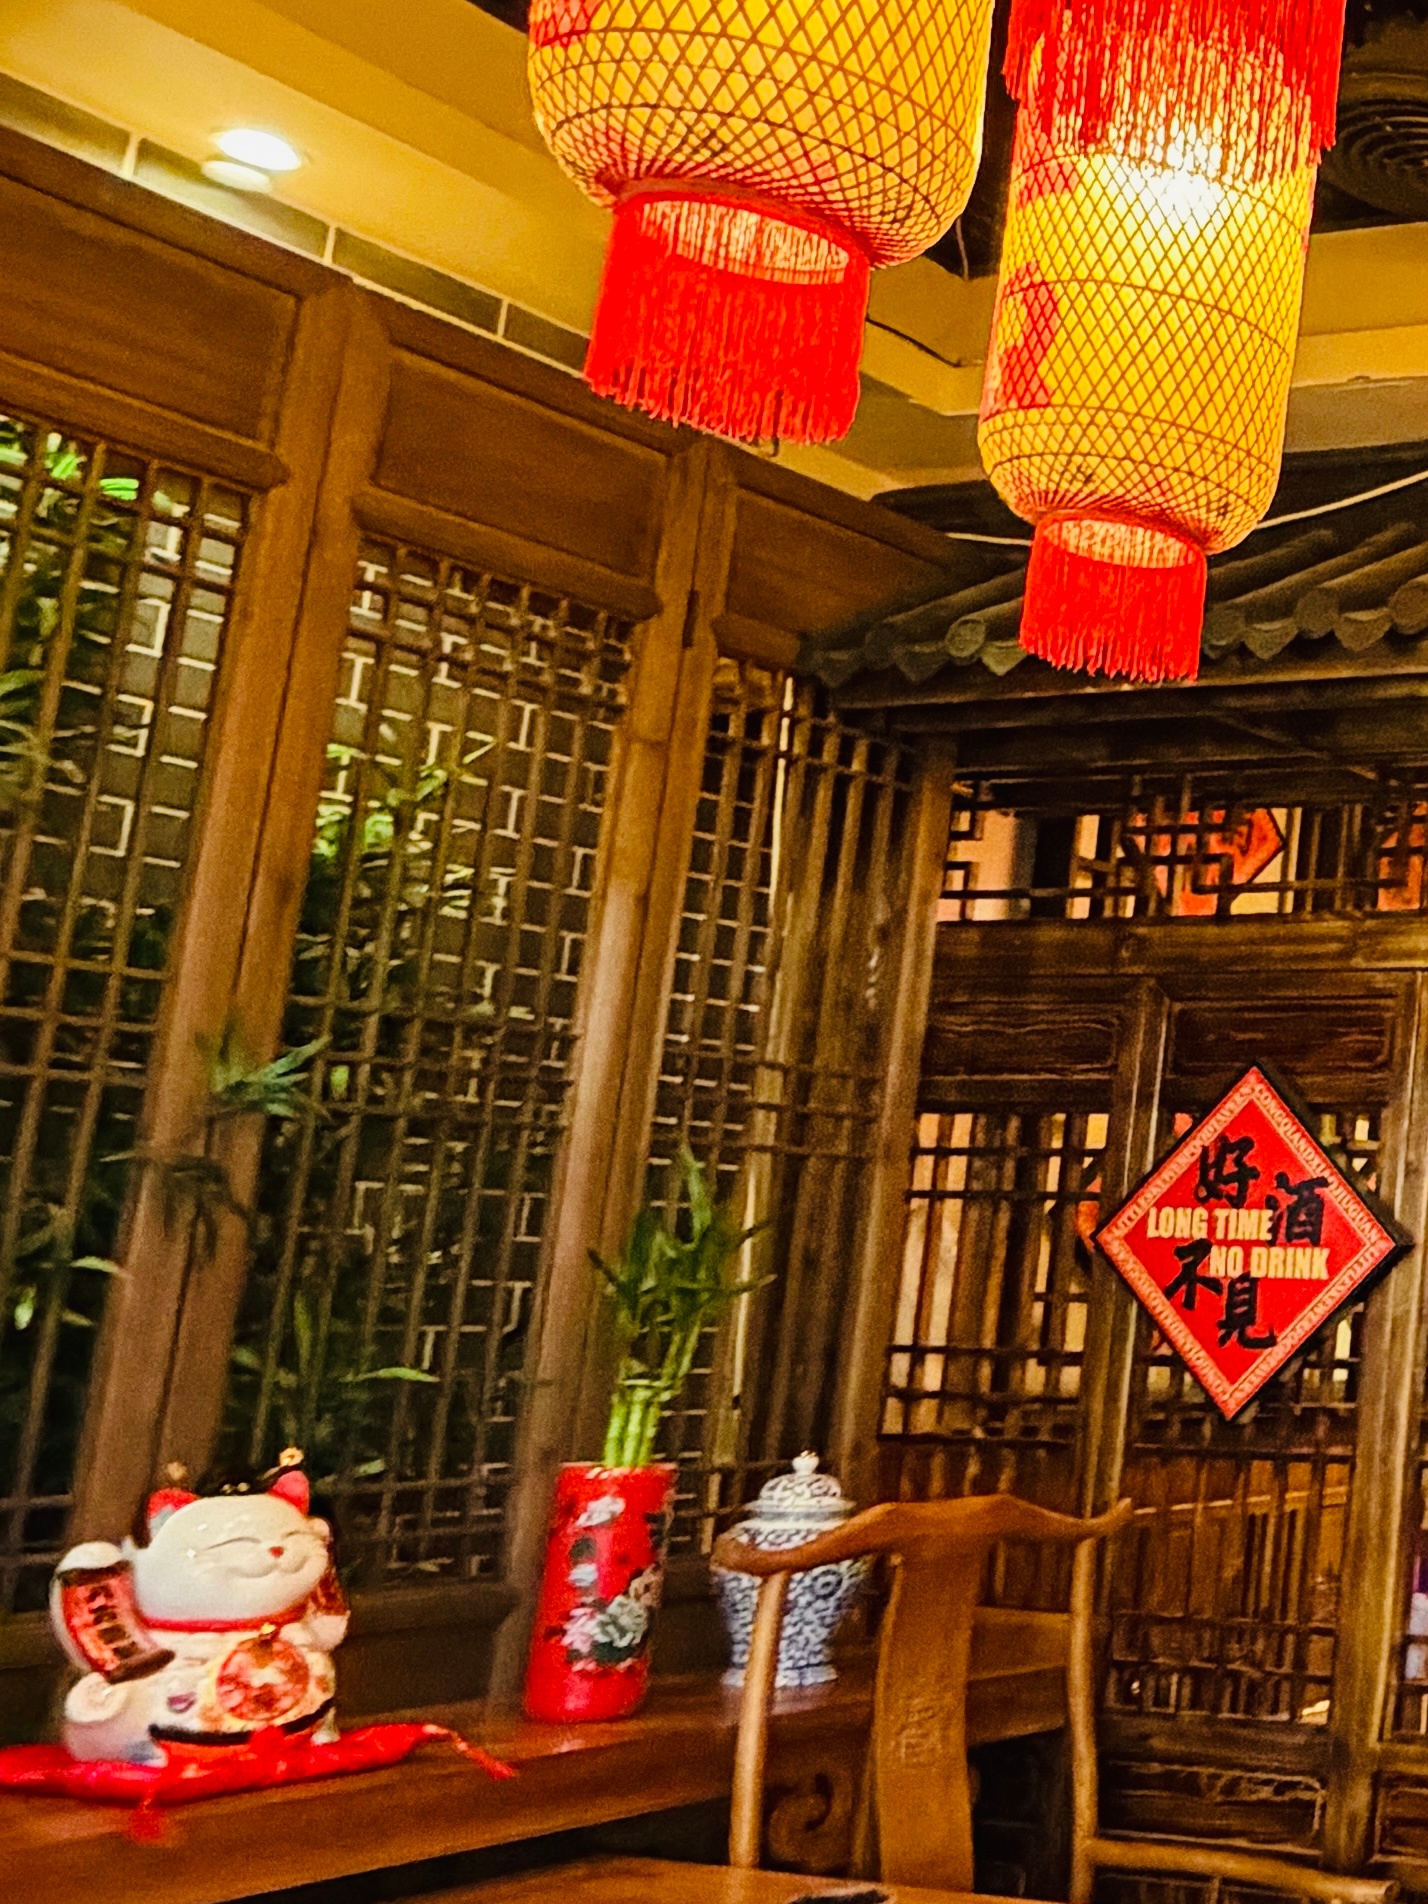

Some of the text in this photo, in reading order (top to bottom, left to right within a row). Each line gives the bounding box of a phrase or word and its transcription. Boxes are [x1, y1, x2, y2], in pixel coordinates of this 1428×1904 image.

[1147, 1207, 1274, 1241] LONG TIME
[1210, 1246, 1330, 1281] NO DRINK
